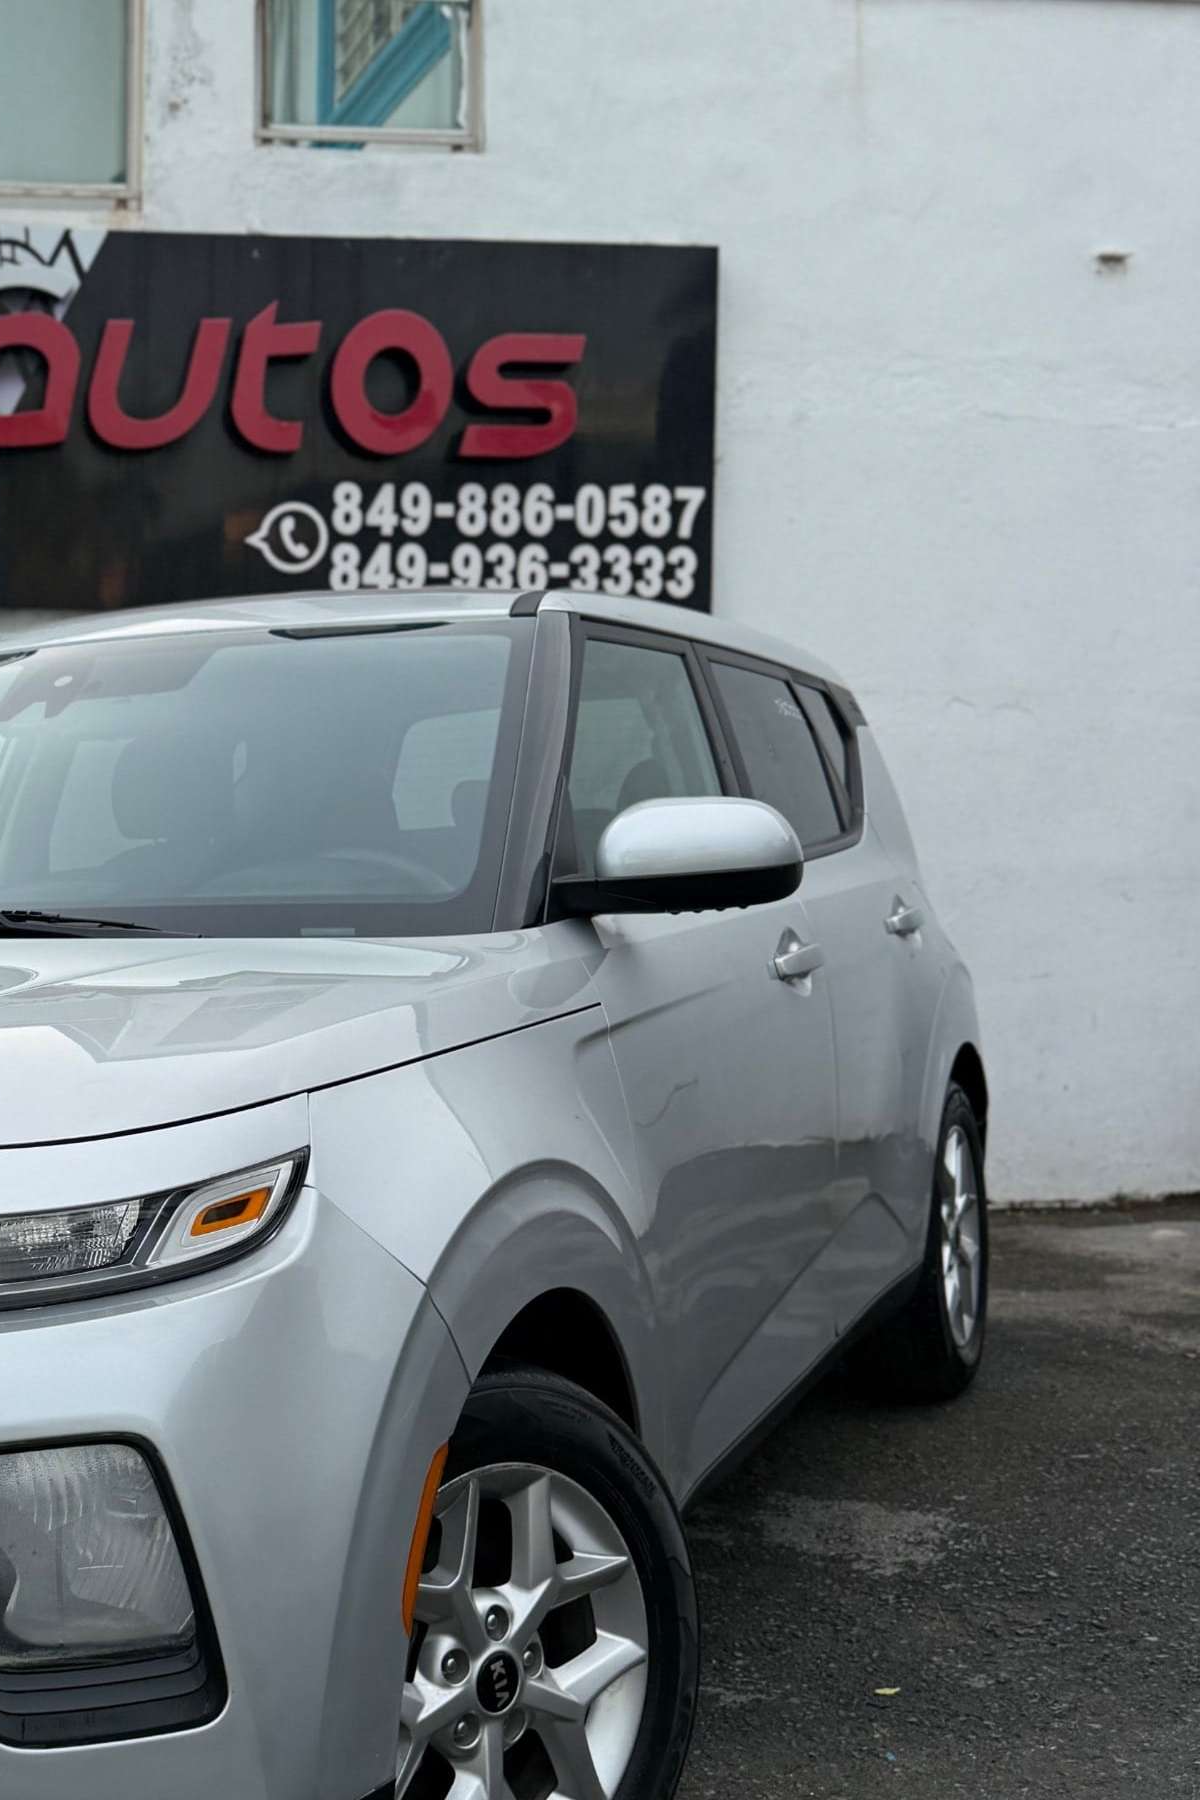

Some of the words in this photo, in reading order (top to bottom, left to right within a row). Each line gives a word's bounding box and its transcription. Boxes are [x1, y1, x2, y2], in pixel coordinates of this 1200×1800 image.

[332, 481, 706, 540] 849-886-0587
[329, 542, 699, 599] 849-936-3333
[490, 1659, 510, 1708] KIA
